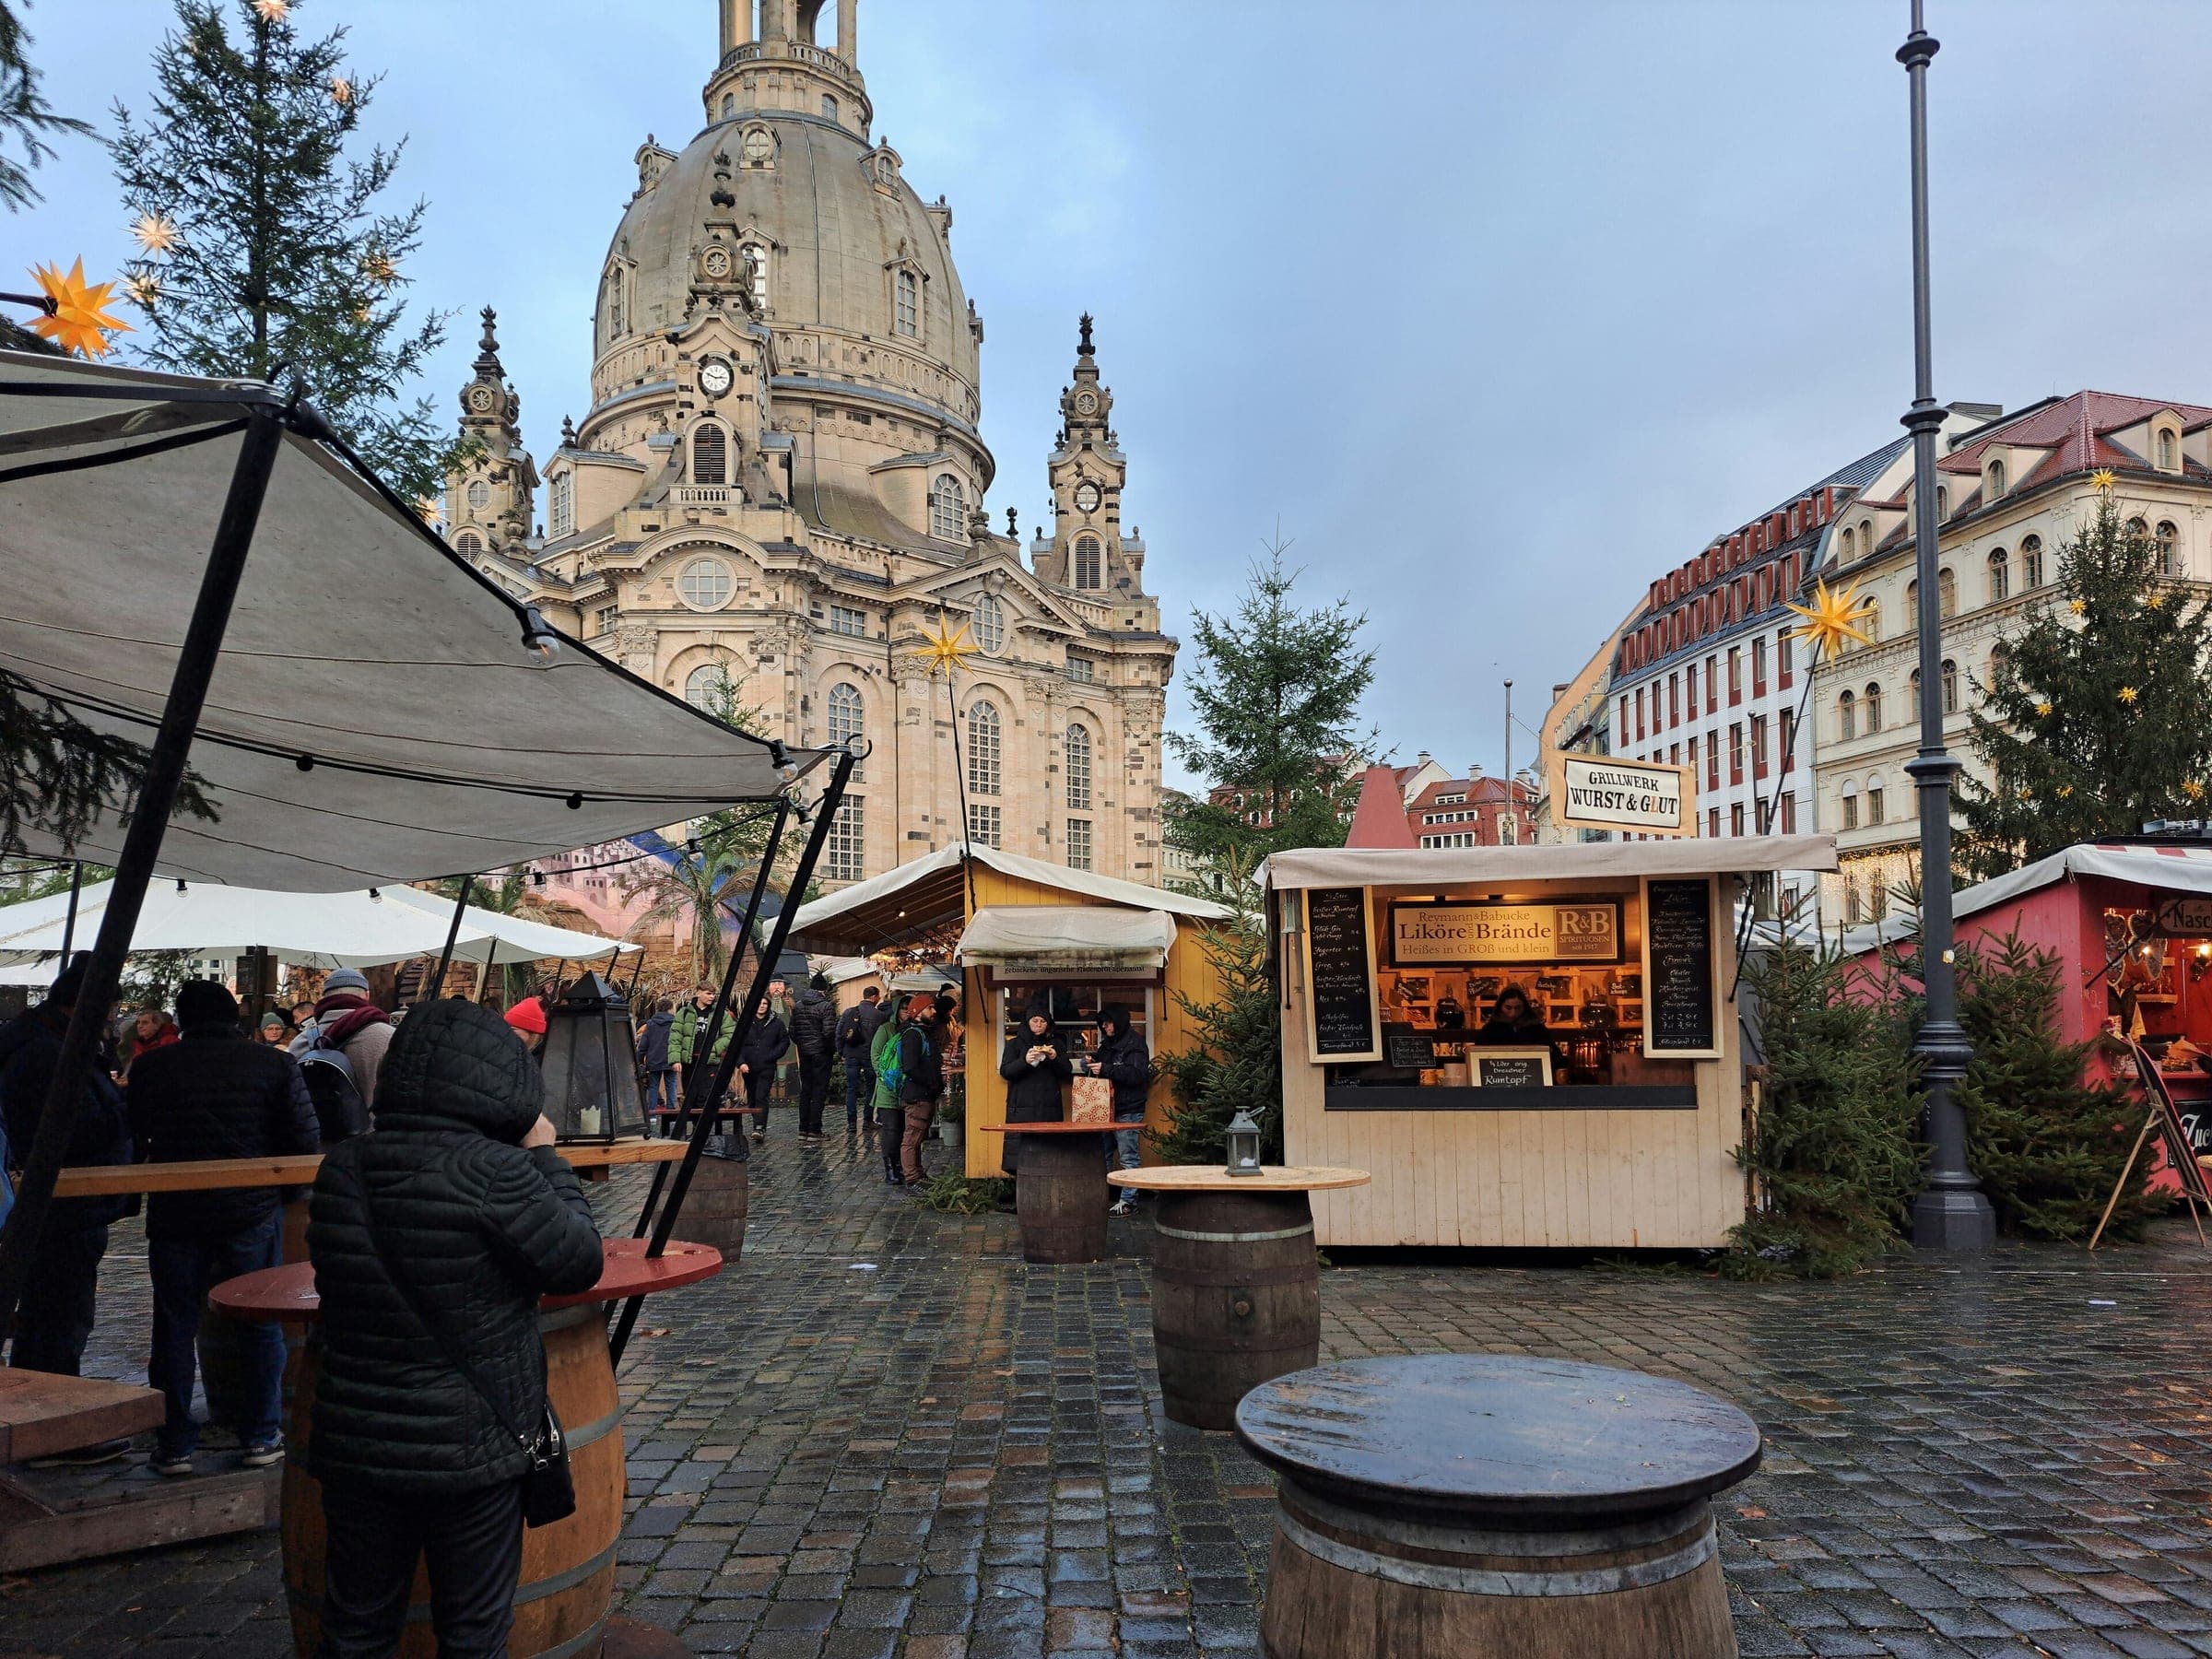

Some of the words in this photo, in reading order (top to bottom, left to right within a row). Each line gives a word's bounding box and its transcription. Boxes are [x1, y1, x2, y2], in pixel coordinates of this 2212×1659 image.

[1853, 659, 1886, 675] GOTTES
[1954, 627, 1984, 642] ALLES
[1589, 771, 1659, 792] GRILLWERK
[1571, 787, 1624, 810] WURST
[1626, 794, 1637, 811] &
[1641, 794, 1677, 815] GLUT
[1559, 911, 1611, 935] R&B
[2173, 903, 2212, 928] Nasc
[1399, 923, 1467, 939] Liköre
[1476, 923, 1552, 939] Brände
[1559, 935, 1610, 944] SPIRITUOSEN
[1403, 944, 1439, 955] Heißes
[1443, 944, 1453, 954] in
[1499, 943, 1519, 954] und
[1524, 943, 1549, 953] klein
[1484, 1075, 1533, 1087] Rumtopf
